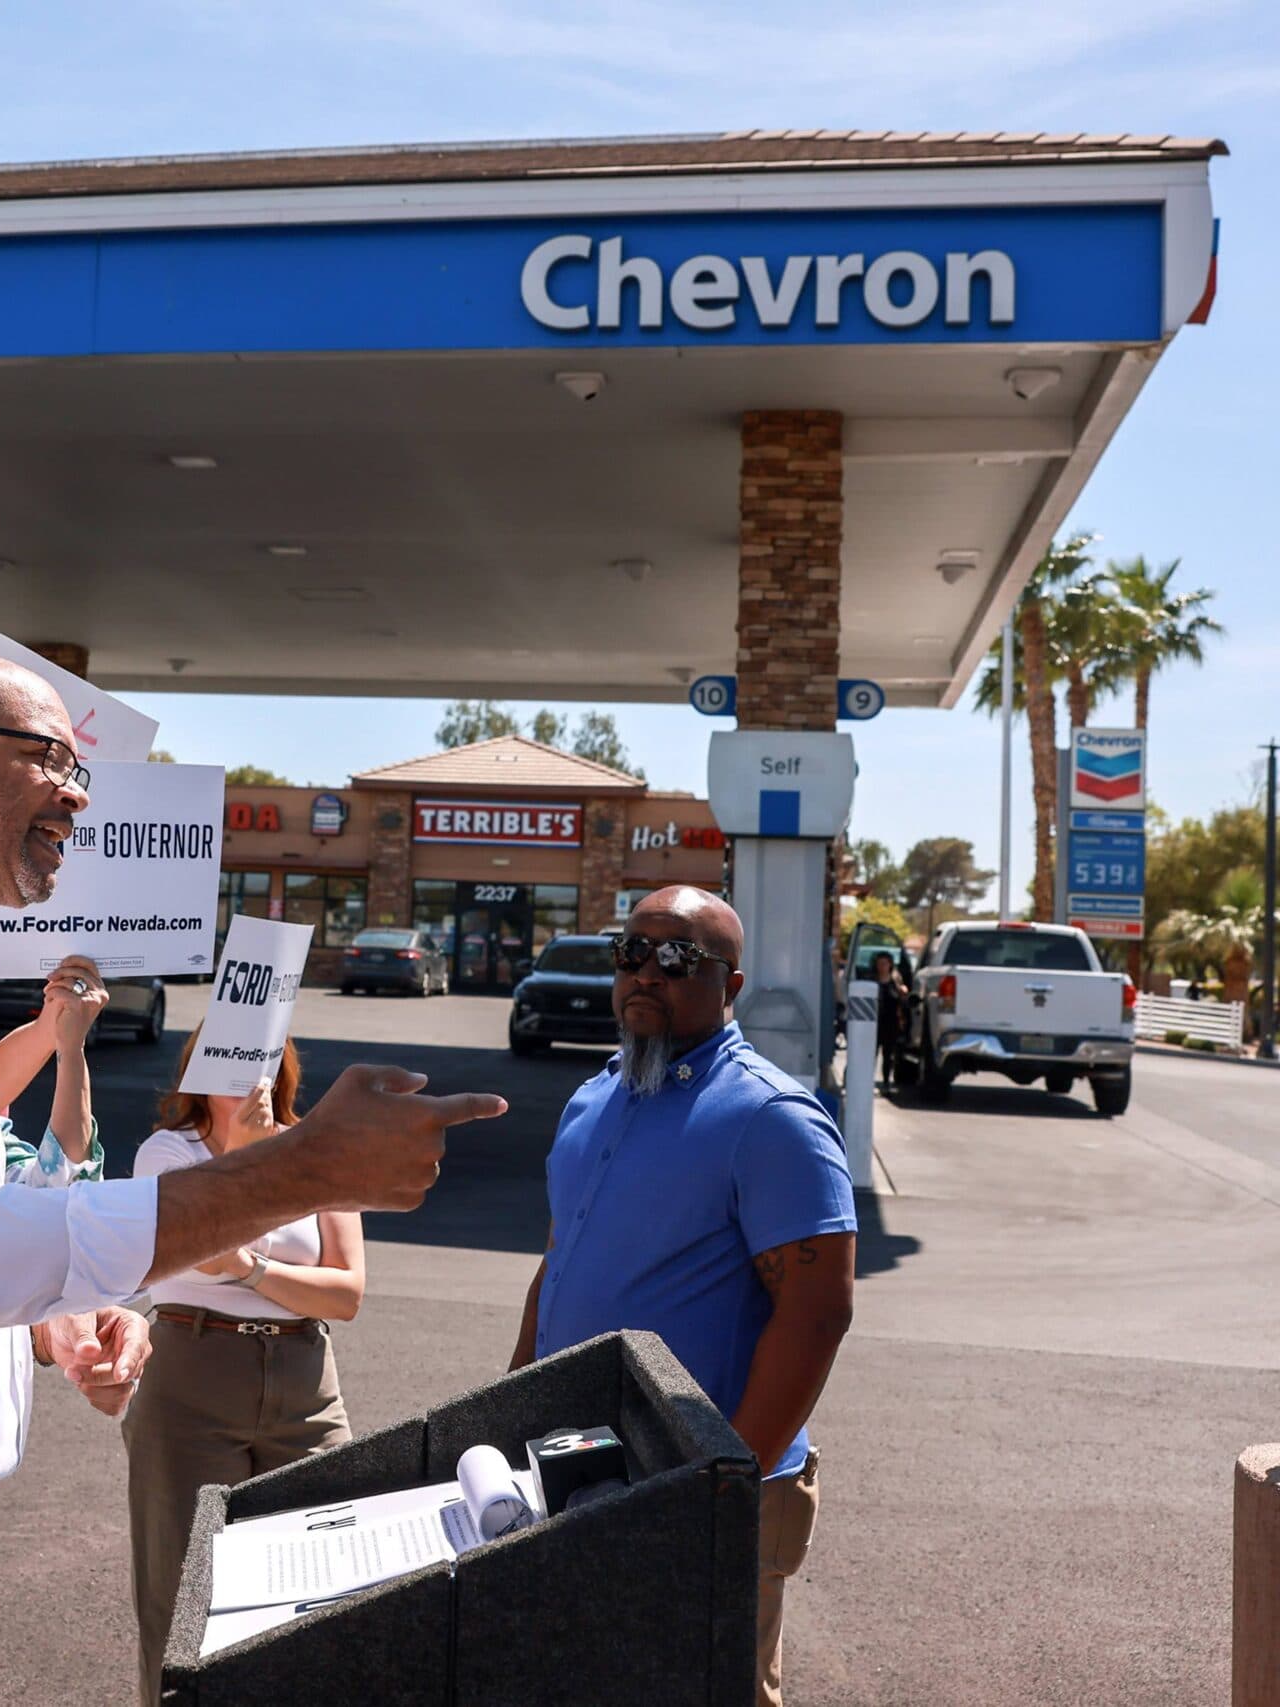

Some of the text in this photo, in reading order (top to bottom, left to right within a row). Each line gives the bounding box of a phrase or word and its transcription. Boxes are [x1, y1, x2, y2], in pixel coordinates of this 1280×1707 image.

[521, 234, 1015, 329] Chevron
[697, 687, 723, 705] 10
[855, 691, 871, 710] 9
[1077, 732, 1143, 747] Chevron
[761, 756, 801, 775] Self
[229, 804, 281, 832] DA
[420, 809, 575, 837] TERRIBLE'S
[73, 822, 213, 859] FOR GOVERNOR
[632, 821, 725, 851] Hot CO
[474, 884, 517, 902] 2237
[107, 915, 202, 932] Nevada.com
[217, 960, 273, 1006] FORD
